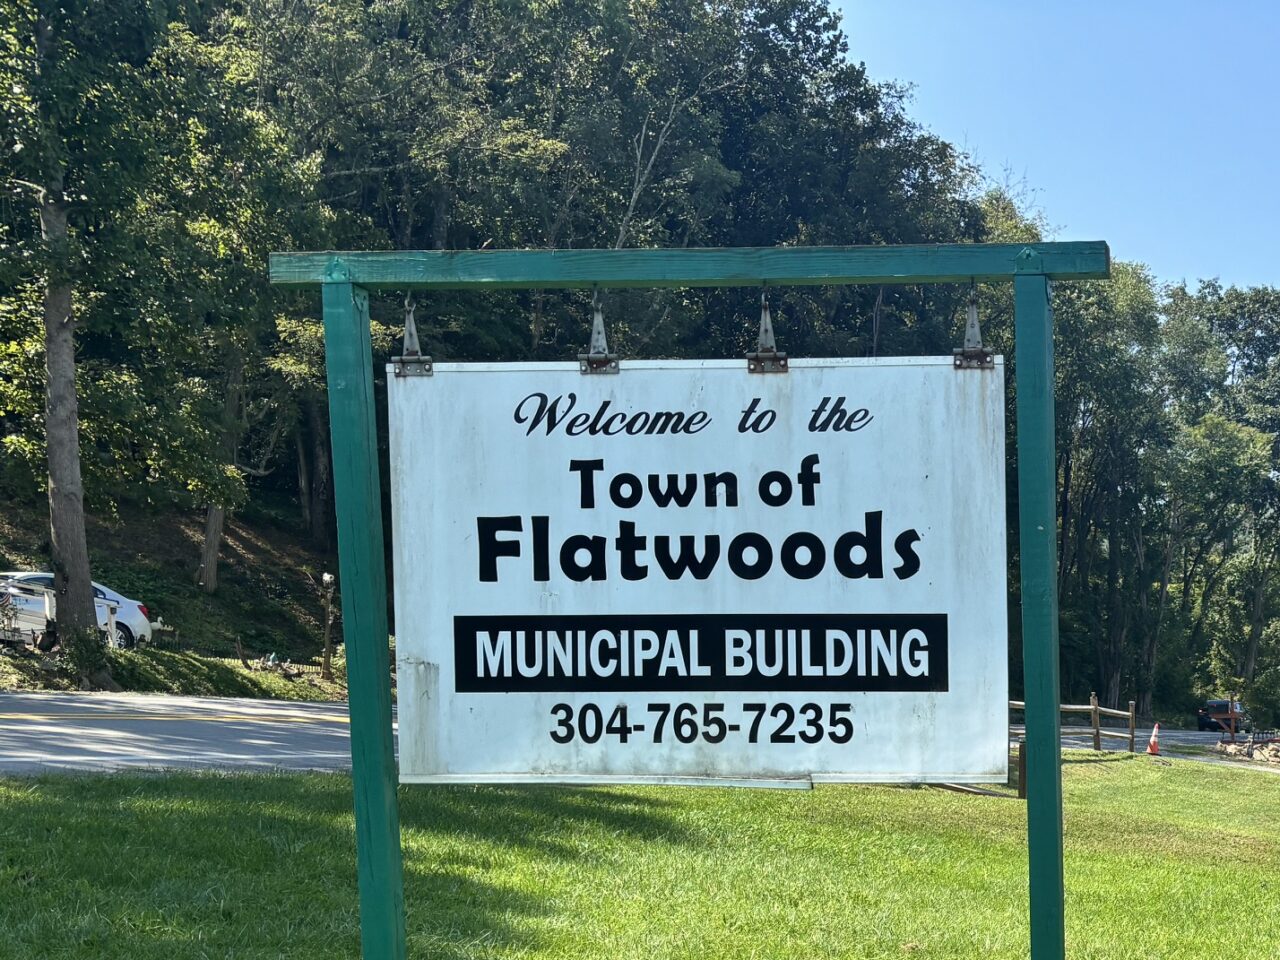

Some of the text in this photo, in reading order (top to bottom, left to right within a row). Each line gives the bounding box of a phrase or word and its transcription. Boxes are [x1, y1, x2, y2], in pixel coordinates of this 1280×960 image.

[514, 393, 874, 436] Welcome to the
[569, 453, 821, 509] Town of
[476, 510, 922, 583] Flatwoods
[475, 628, 930, 678] MUNICIPAL BUILDING
[549, 702, 854, 744] 304-765-7235
